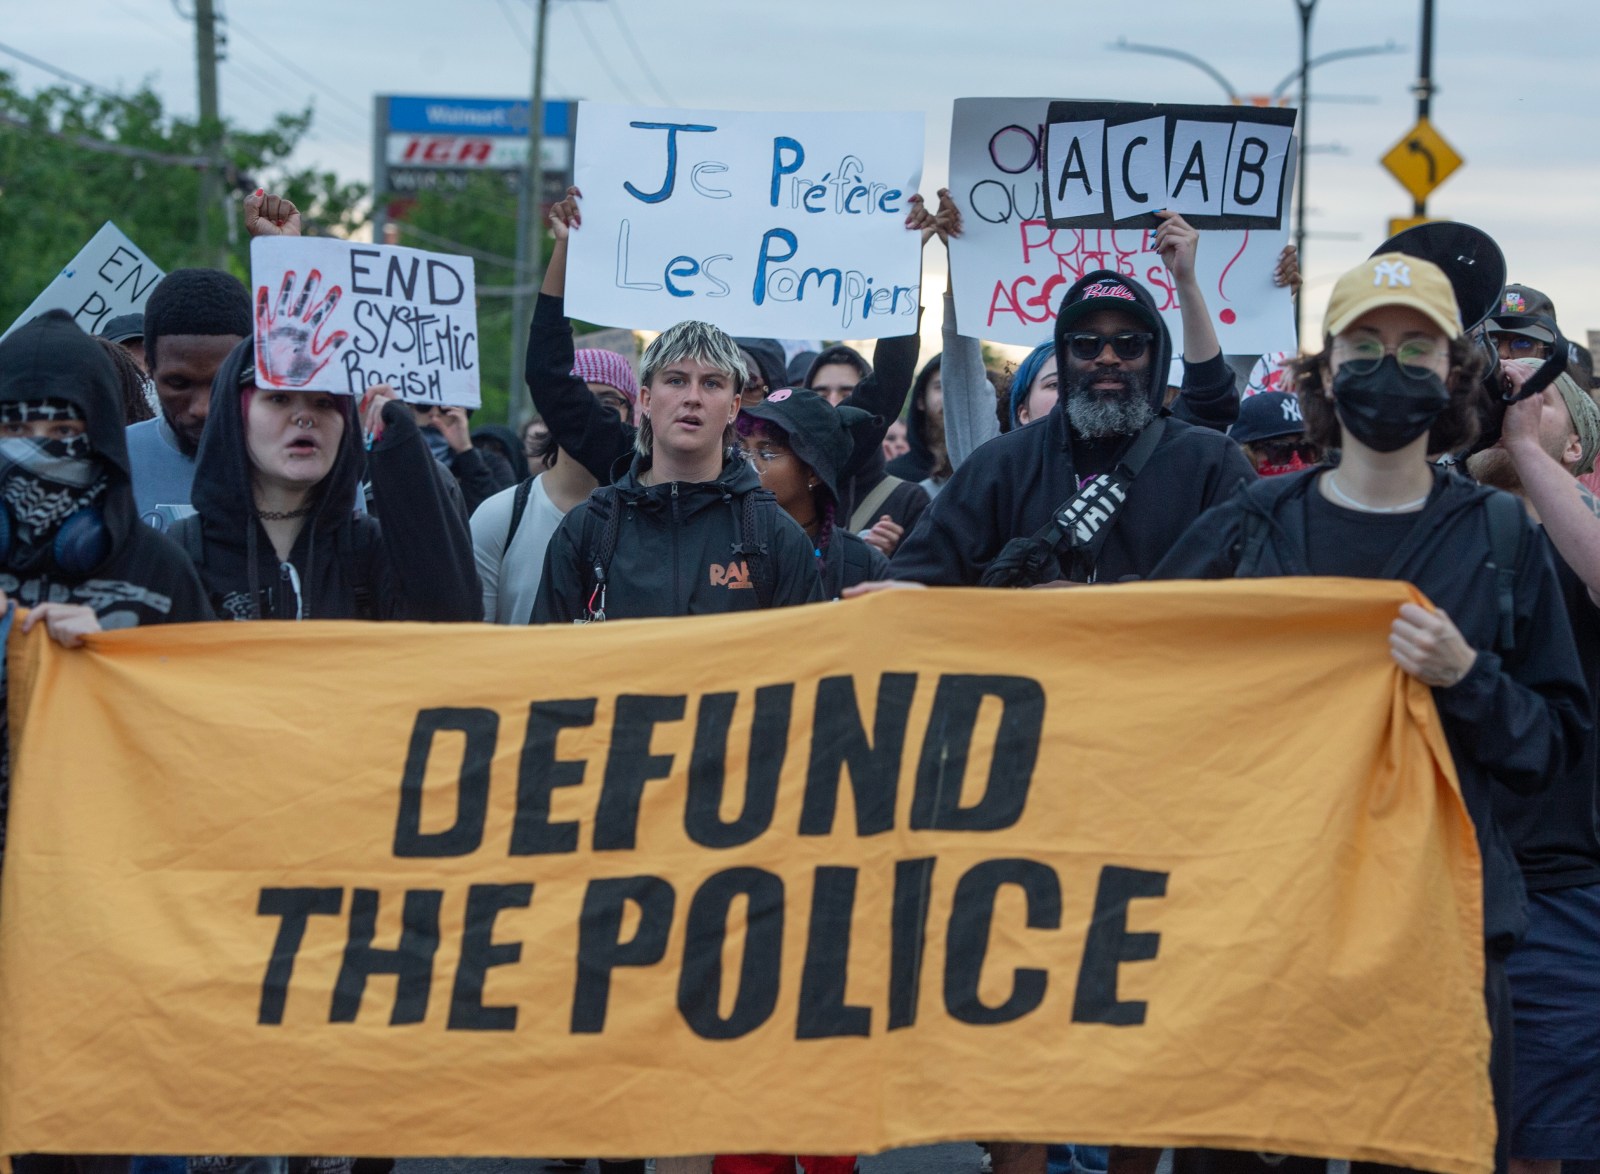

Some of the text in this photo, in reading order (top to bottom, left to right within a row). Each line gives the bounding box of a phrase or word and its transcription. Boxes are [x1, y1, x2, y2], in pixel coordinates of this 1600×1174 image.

[404, 138, 492, 164] IGA
[623, 121, 902, 215] Je Préfère
[1058, 135, 1269, 206] ACAB
[970, 180, 1046, 224] QU
[350, 249, 464, 305] END
[615, 219, 919, 328] Les Pompiers
[392, 671, 1046, 858] DEFUND
[257, 856, 1170, 1042] THE POLICE
